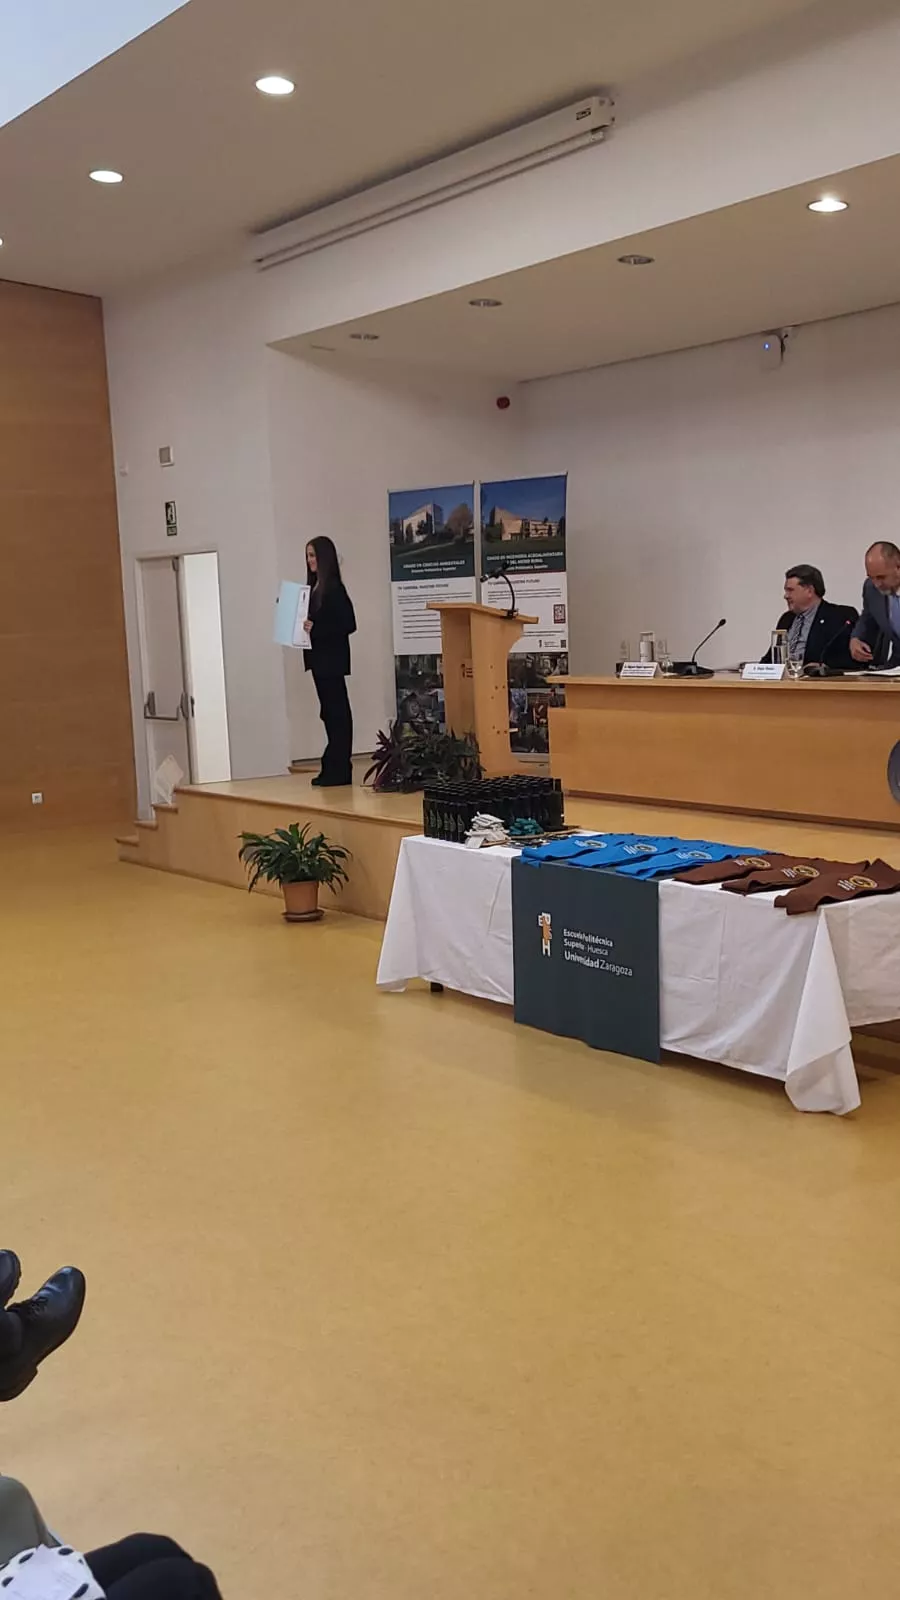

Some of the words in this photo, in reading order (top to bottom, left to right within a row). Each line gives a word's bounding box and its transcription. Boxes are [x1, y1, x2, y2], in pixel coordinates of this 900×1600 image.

[563, 938, 585, 950] Supe
[587, 944, 609, 956] Huesca
[564, 950, 600, 968] Unividad
[600, 959, 633, 976] Zaragoza
